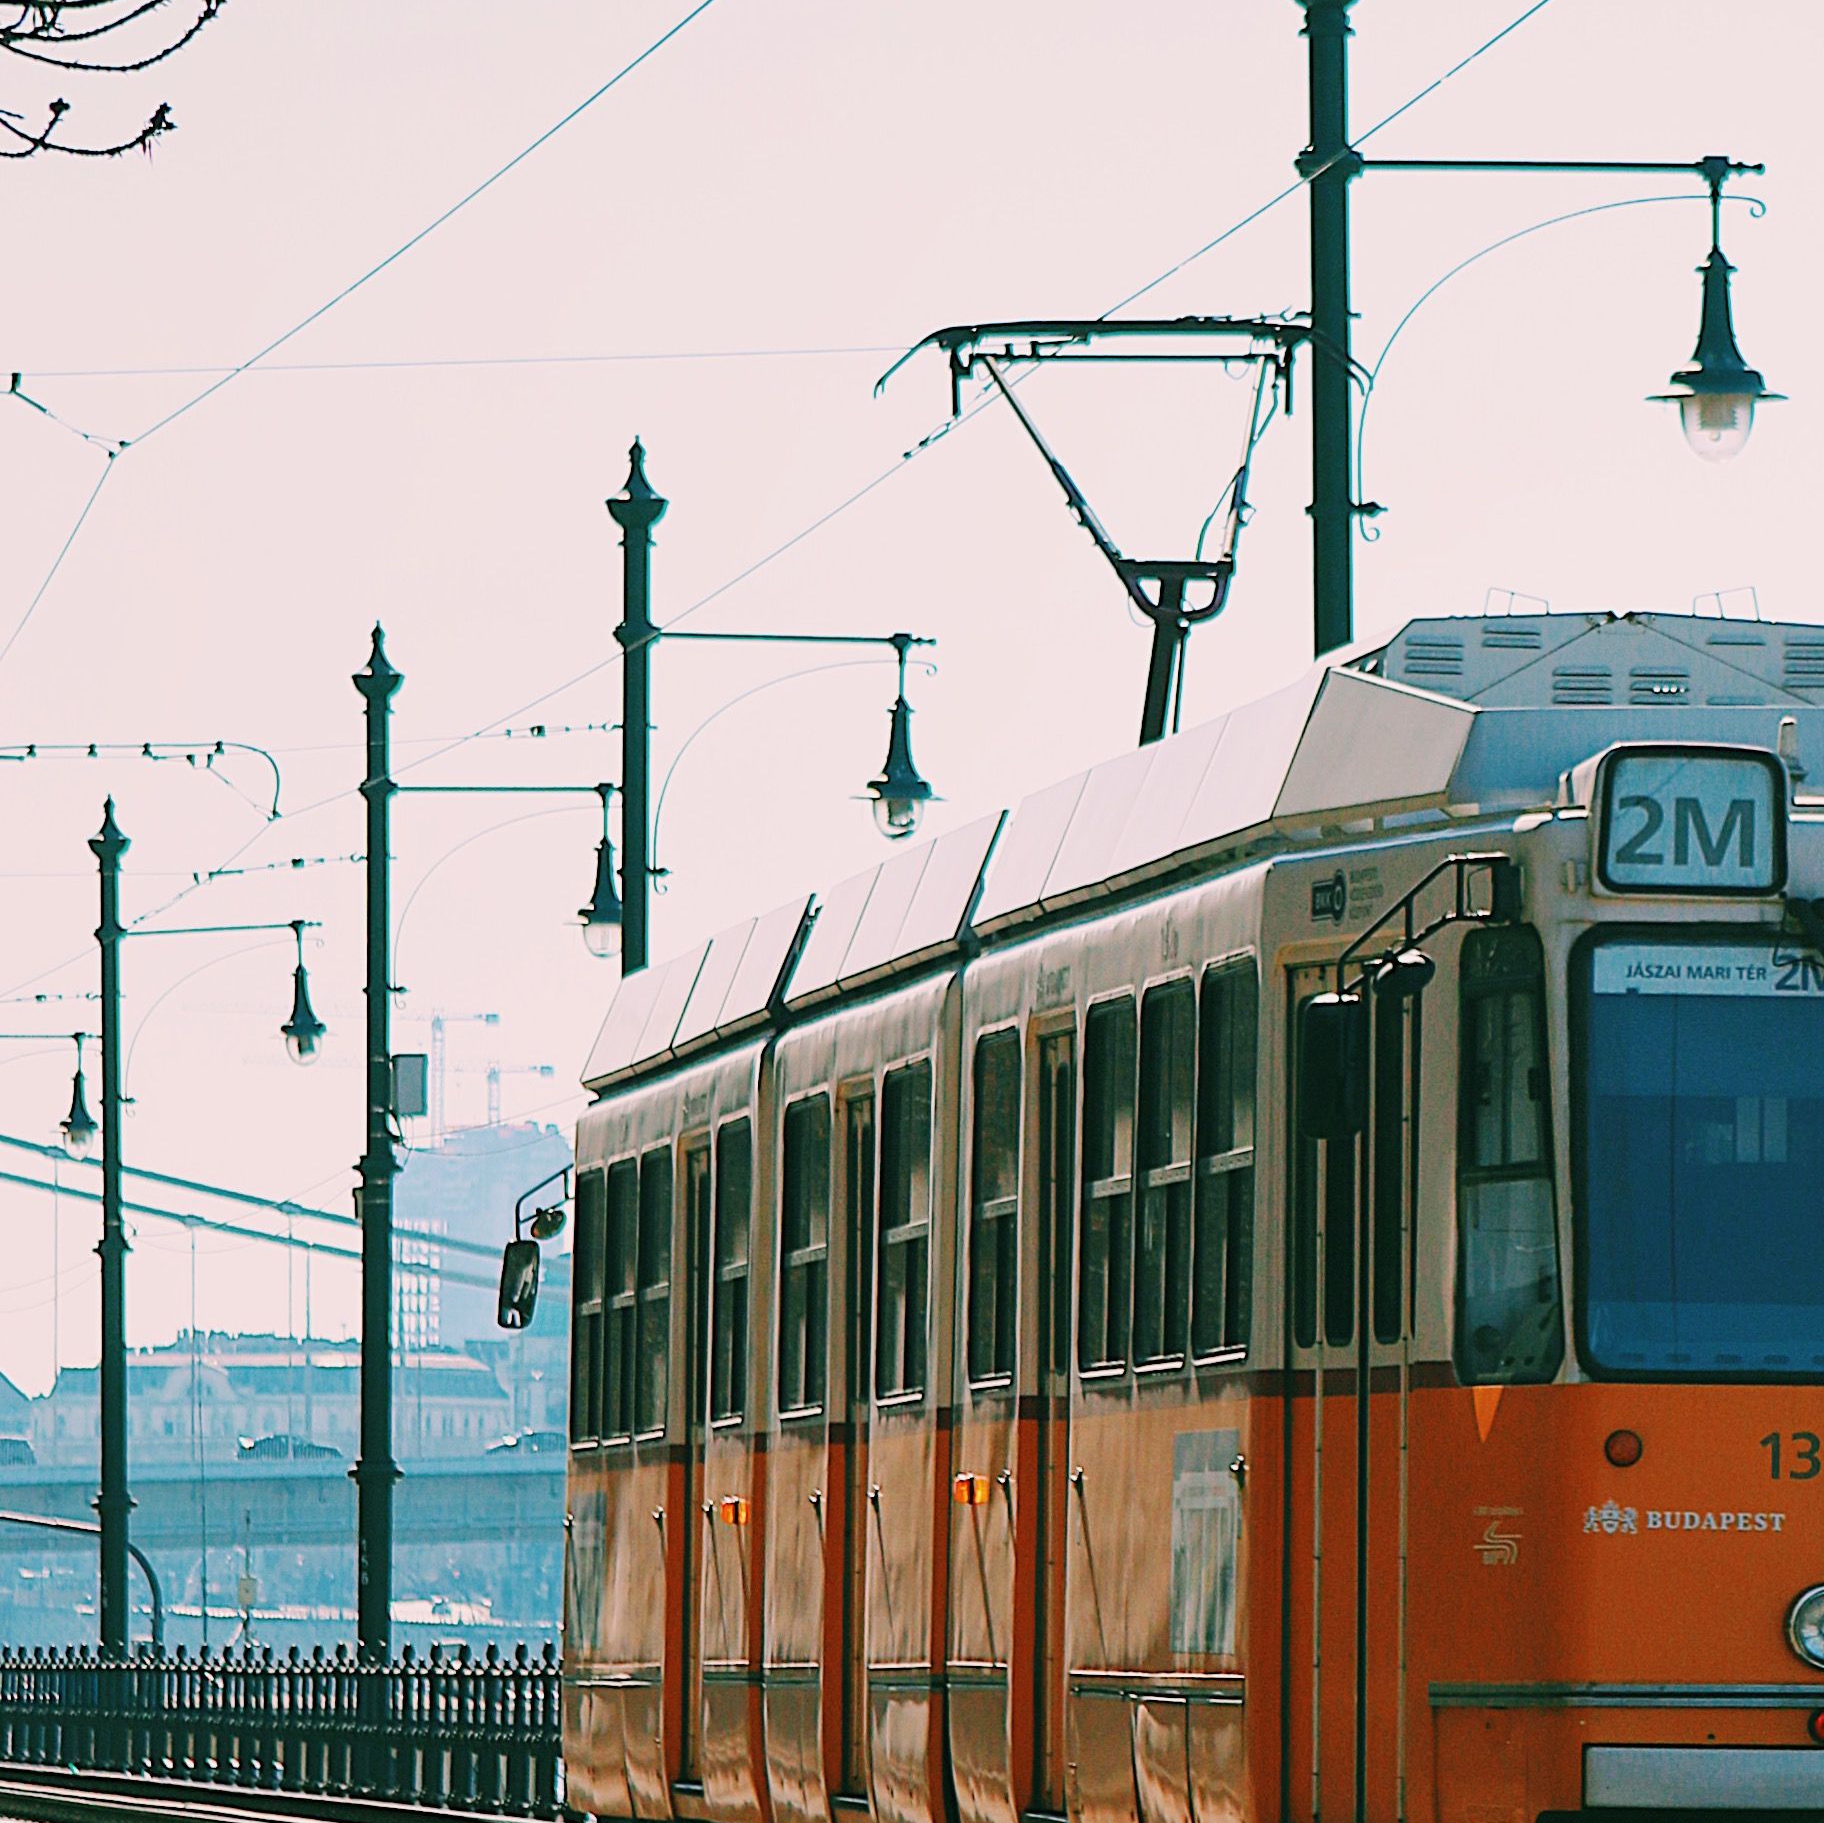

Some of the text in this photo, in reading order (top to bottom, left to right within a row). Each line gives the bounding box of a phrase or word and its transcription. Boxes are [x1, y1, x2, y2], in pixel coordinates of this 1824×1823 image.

[1614, 794, 1756, 868] 2M
[1626, 960, 1768, 981] JÁSZAI MARI TÉR
[1645, 1510, 1787, 1532] BUDAPEST
